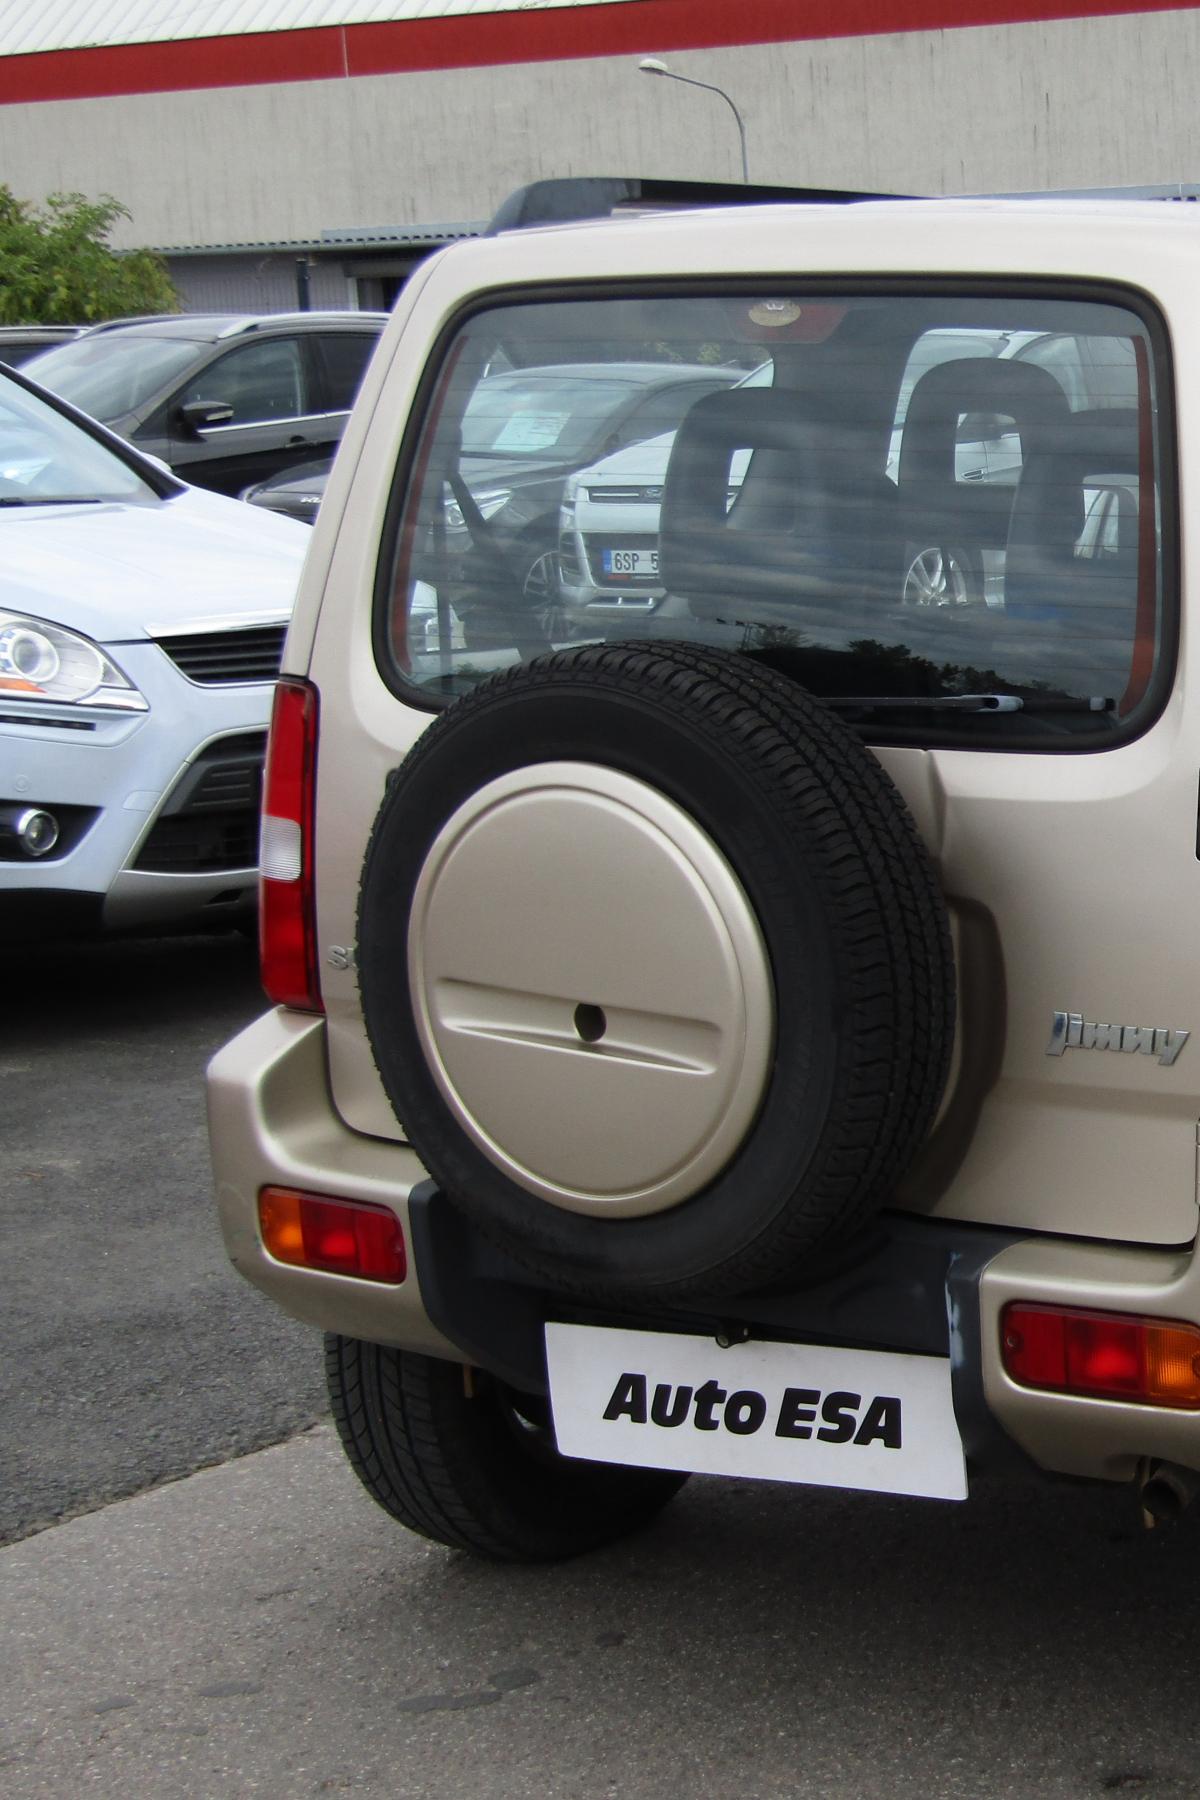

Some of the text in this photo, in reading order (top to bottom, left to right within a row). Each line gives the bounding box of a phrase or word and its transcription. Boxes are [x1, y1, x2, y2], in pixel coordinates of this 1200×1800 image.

[614, 552, 640, 571] 6SP
[603, 1372, 902, 1449] Auto ESA
